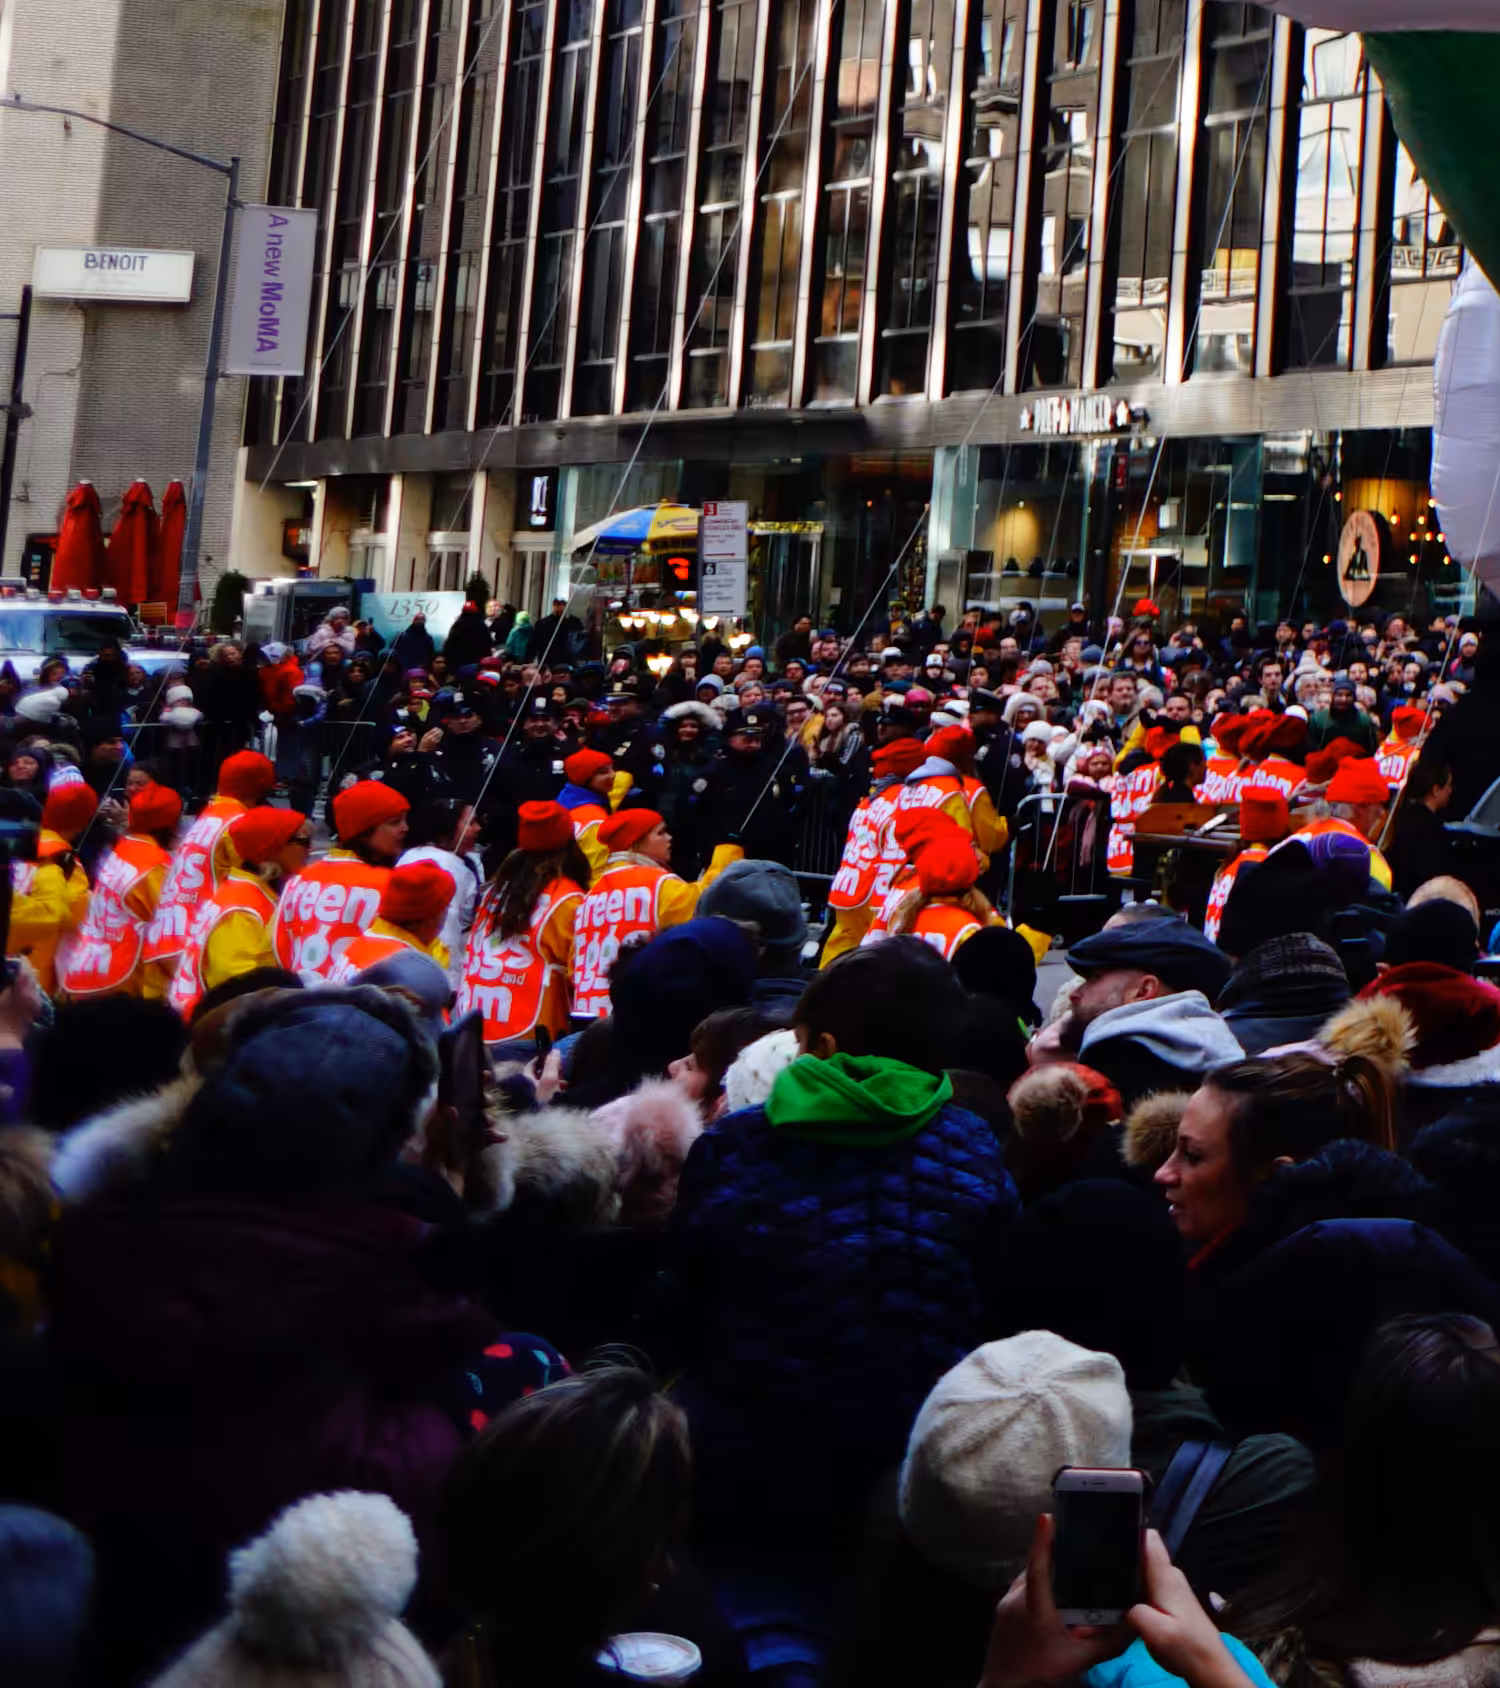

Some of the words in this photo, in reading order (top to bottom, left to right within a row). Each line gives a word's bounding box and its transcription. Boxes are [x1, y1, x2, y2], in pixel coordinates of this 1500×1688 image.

[268, 213, 289, 228] A
[84, 253, 148, 272] BENOIT
[265, 233, 284, 276] new
[255, 282, 285, 352] MoMA
[388, 598, 439, 618] 1350
[501, 972, 526, 985] and
